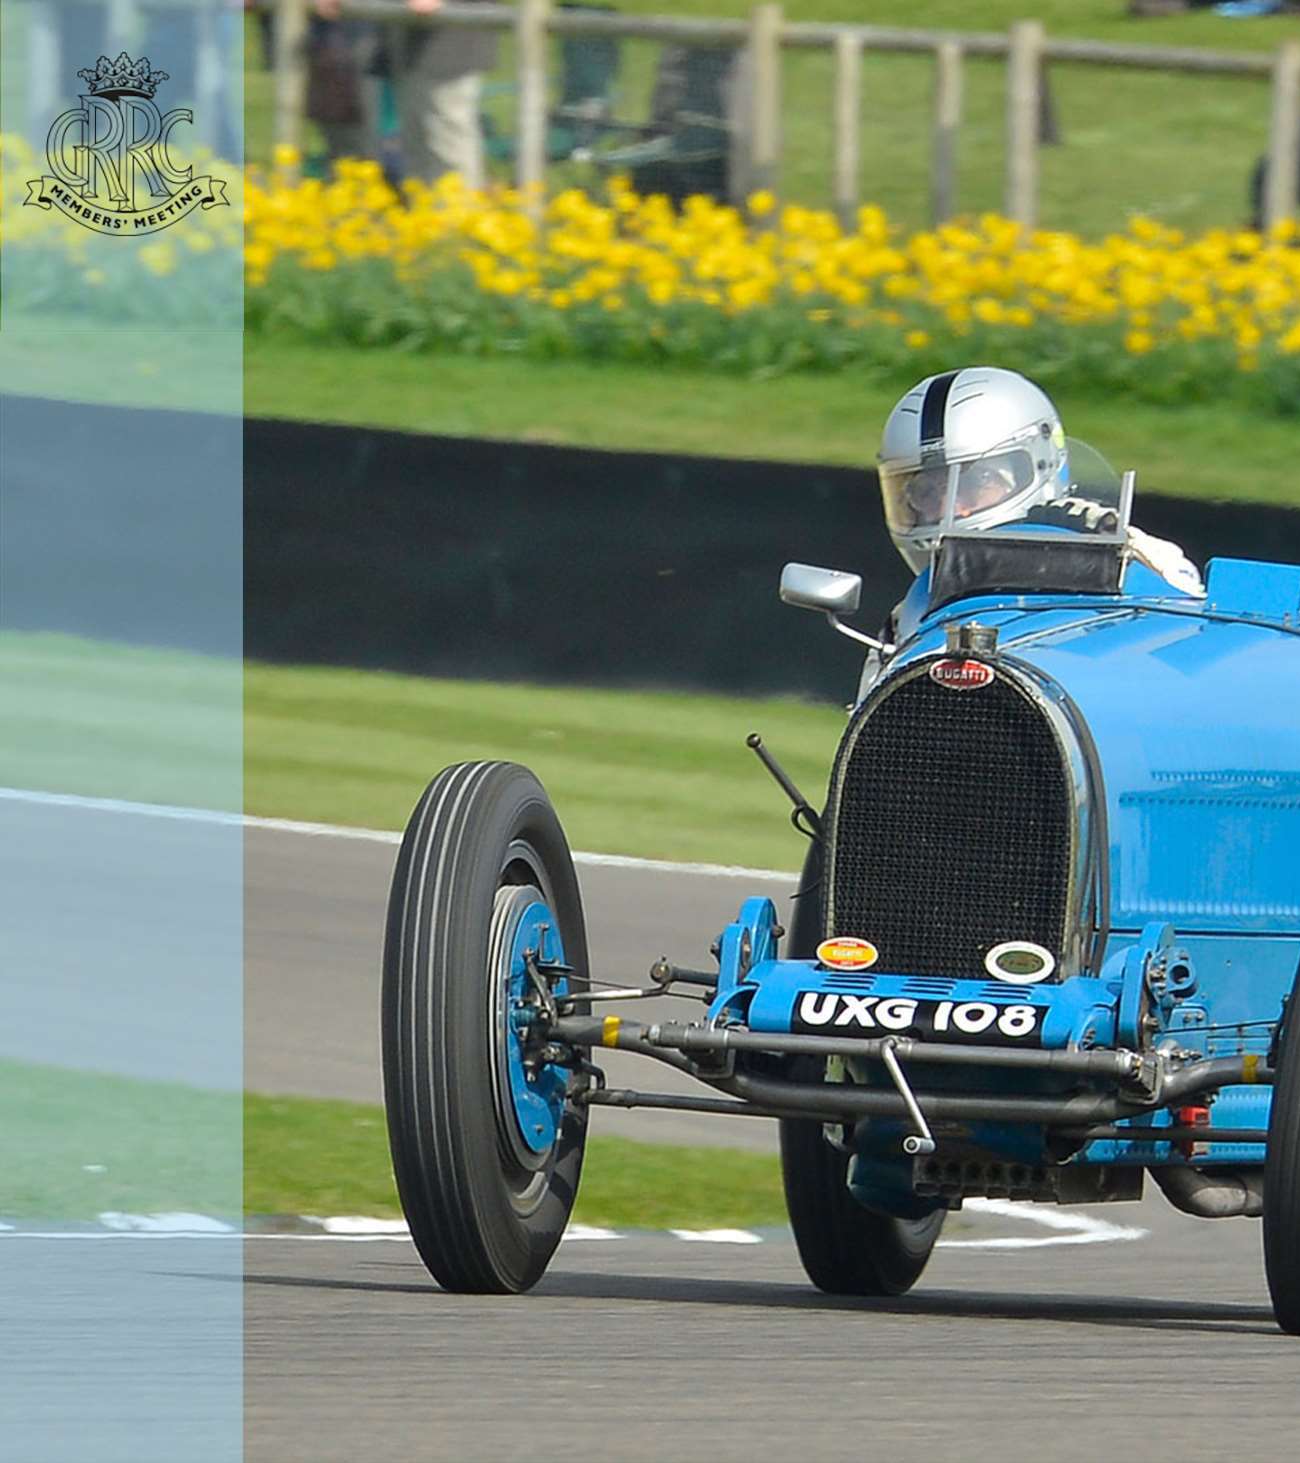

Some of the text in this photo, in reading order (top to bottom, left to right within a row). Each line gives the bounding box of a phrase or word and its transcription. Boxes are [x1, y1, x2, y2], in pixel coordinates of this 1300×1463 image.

[936, 668, 985, 681] BUGATTI
[800, 992, 1036, 1037] UXG 108
